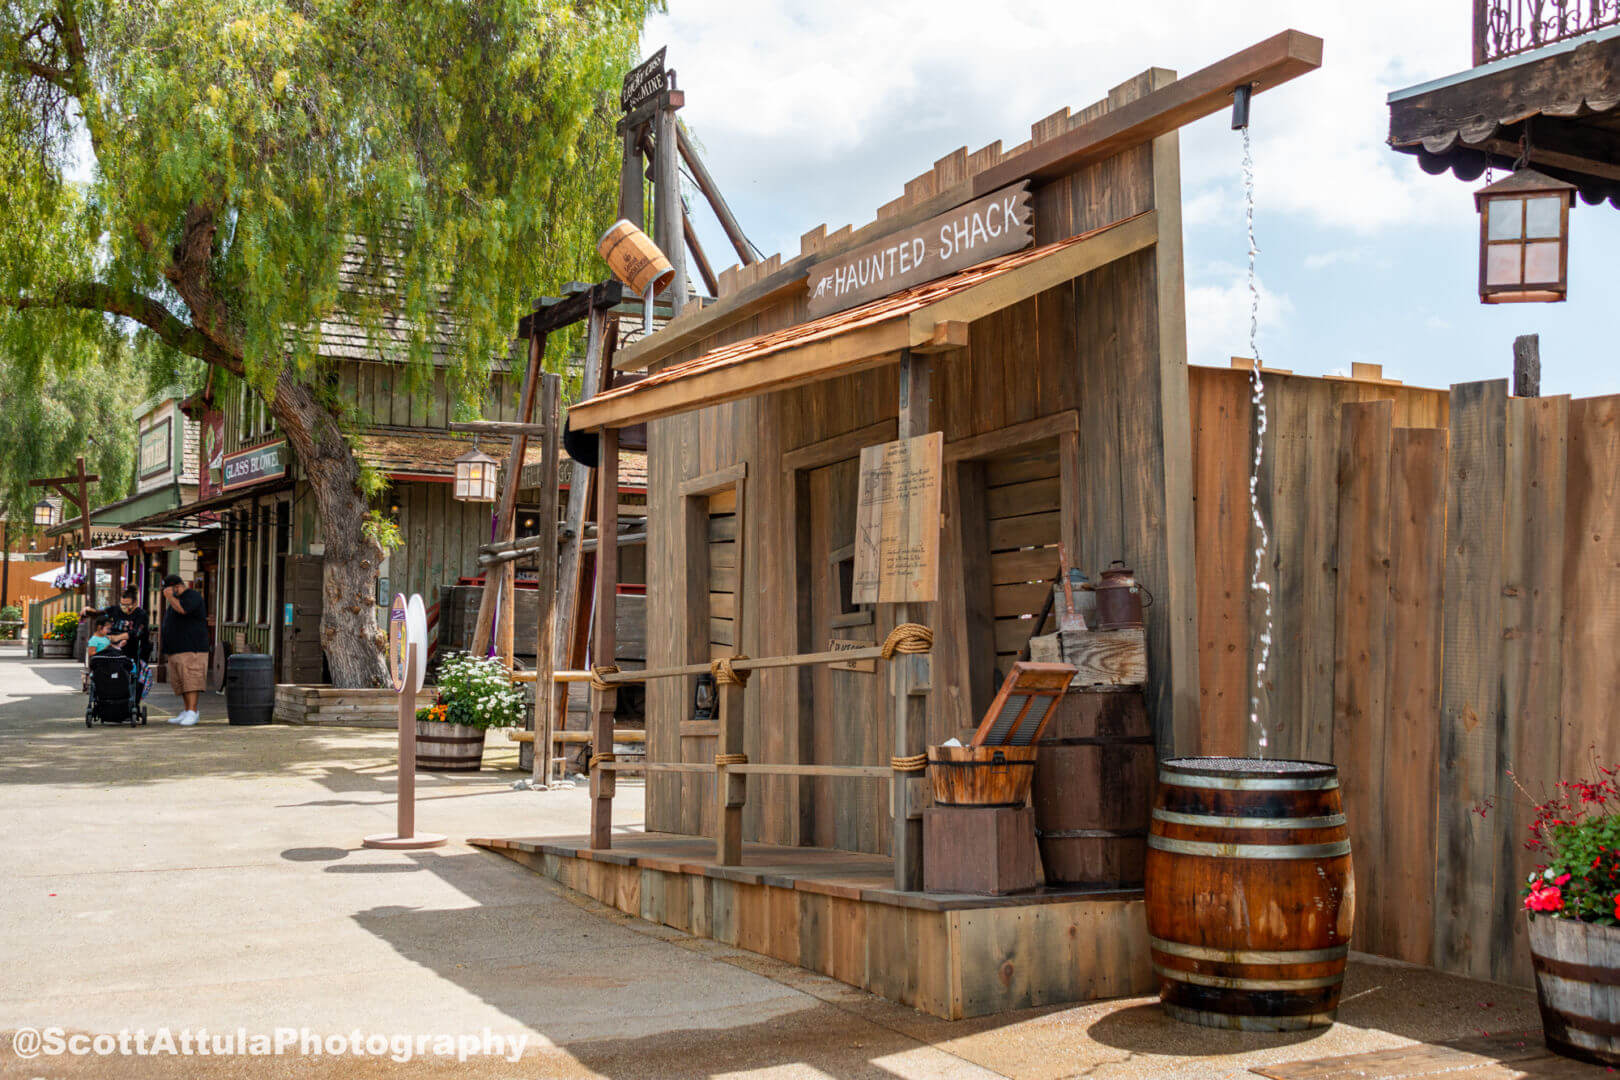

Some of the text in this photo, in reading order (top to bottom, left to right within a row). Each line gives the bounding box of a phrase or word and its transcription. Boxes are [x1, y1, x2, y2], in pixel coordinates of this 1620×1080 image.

[640, 73, 664, 99] MINE
[834, 237, 926, 297] HAUNTED
[939, 194, 1021, 261] SHACK
[225, 451, 279, 480] GLASS BLOWE
